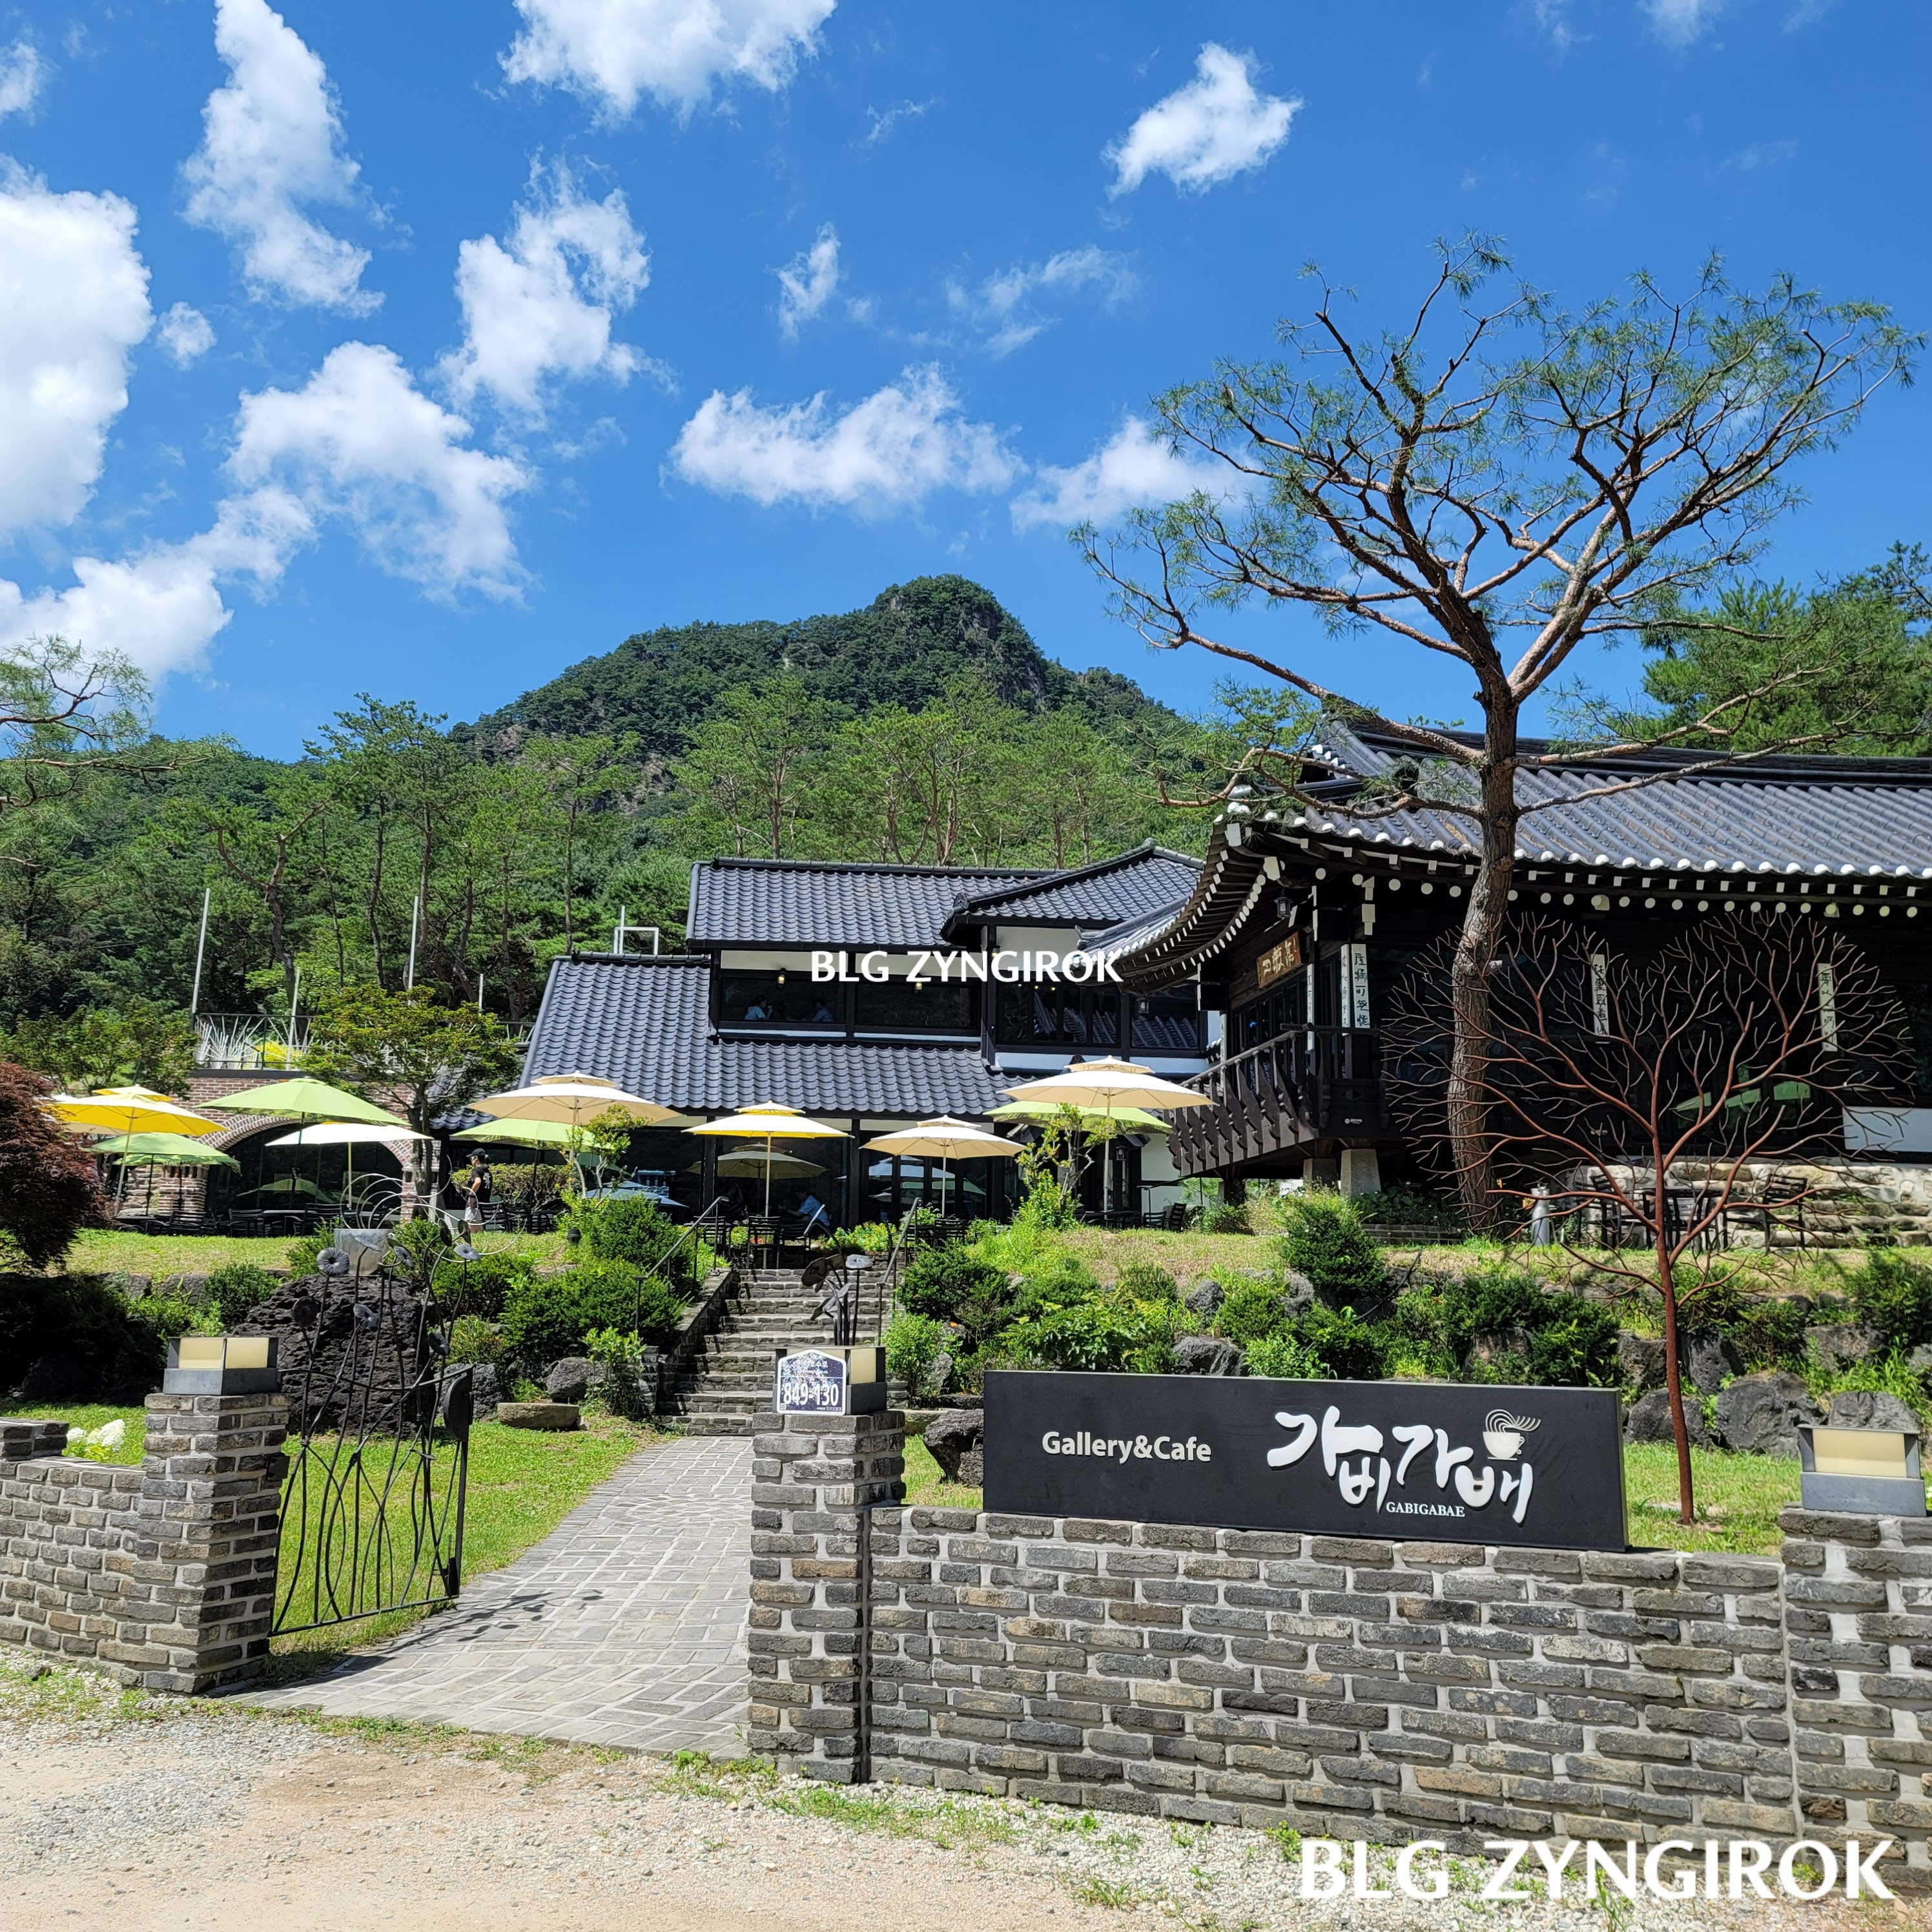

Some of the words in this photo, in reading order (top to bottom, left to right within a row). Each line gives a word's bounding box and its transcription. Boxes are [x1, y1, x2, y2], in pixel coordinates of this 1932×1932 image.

[783, 1382, 839, 1406] 849-130
[1042, 1431, 1212, 1464] Gallery&Cafe
[1267, 1405, 1533, 1523] 가비가배
[1386, 1501, 1466, 1517] GABIGABAE
